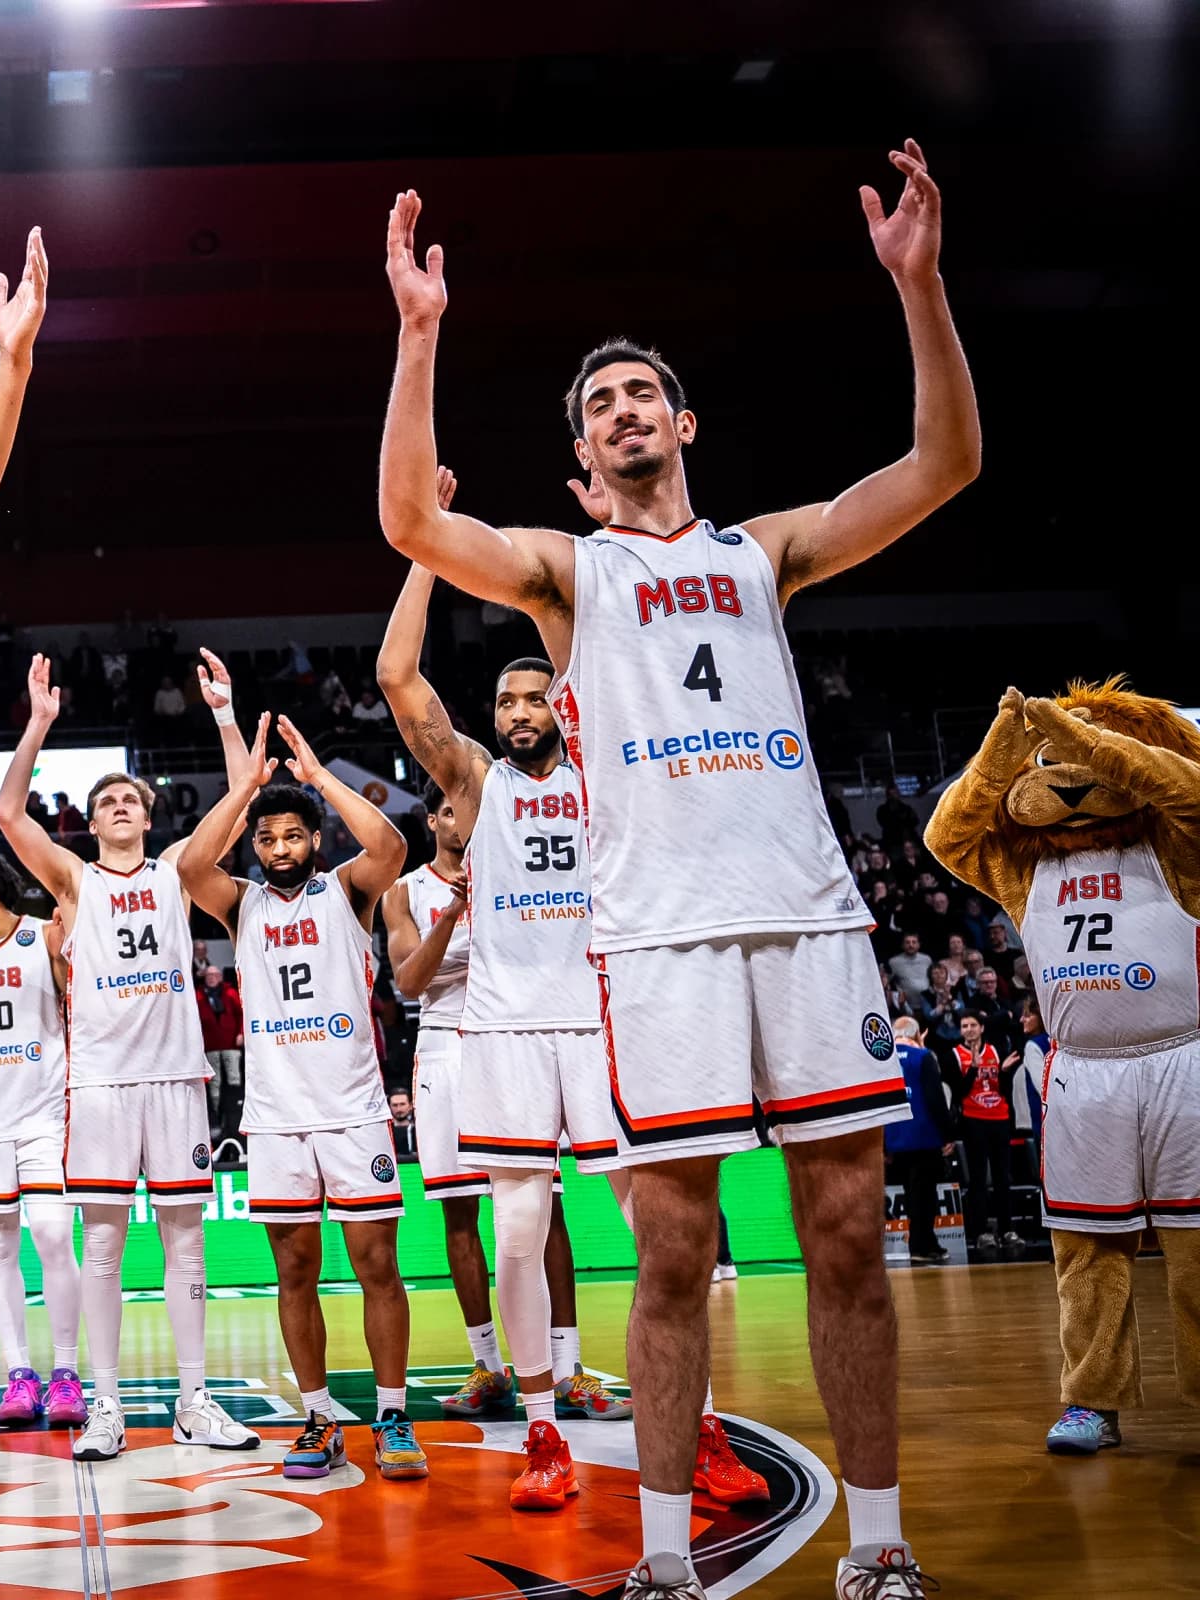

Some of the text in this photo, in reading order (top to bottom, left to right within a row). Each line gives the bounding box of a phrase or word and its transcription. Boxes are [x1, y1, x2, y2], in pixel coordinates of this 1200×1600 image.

[634, 574, 744, 626] MSB
[683, 643, 722, 702] 4
[622, 729, 760, 765] E.Leclerc
[667, 754, 764, 778] LE MANS
[514, 792, 578, 822] MSB
[524, 835, 576, 872] 35
[110, 888, 157, 918] MSB
[494, 890, 584, 910] E.Leclerc
[1057, 873, 1122, 906] MSB
[520, 906, 586, 921] LE MANS
[117, 924, 158, 958] 34
[264, 918, 319, 952] MSB
[1064, 913, 1112, 952] 72
[96, 970, 167, 990] E.Leclerc
[278, 963, 314, 1001] 12
[1042, 962, 1120, 983] E.Leclerc
[1059, 979, 1121, 992] LE MANS
[118, 984, 168, 998] LE MANS
[251, 1016, 324, 1033] E.Leclerc
[276, 1030, 326, 1046] LE MANS
